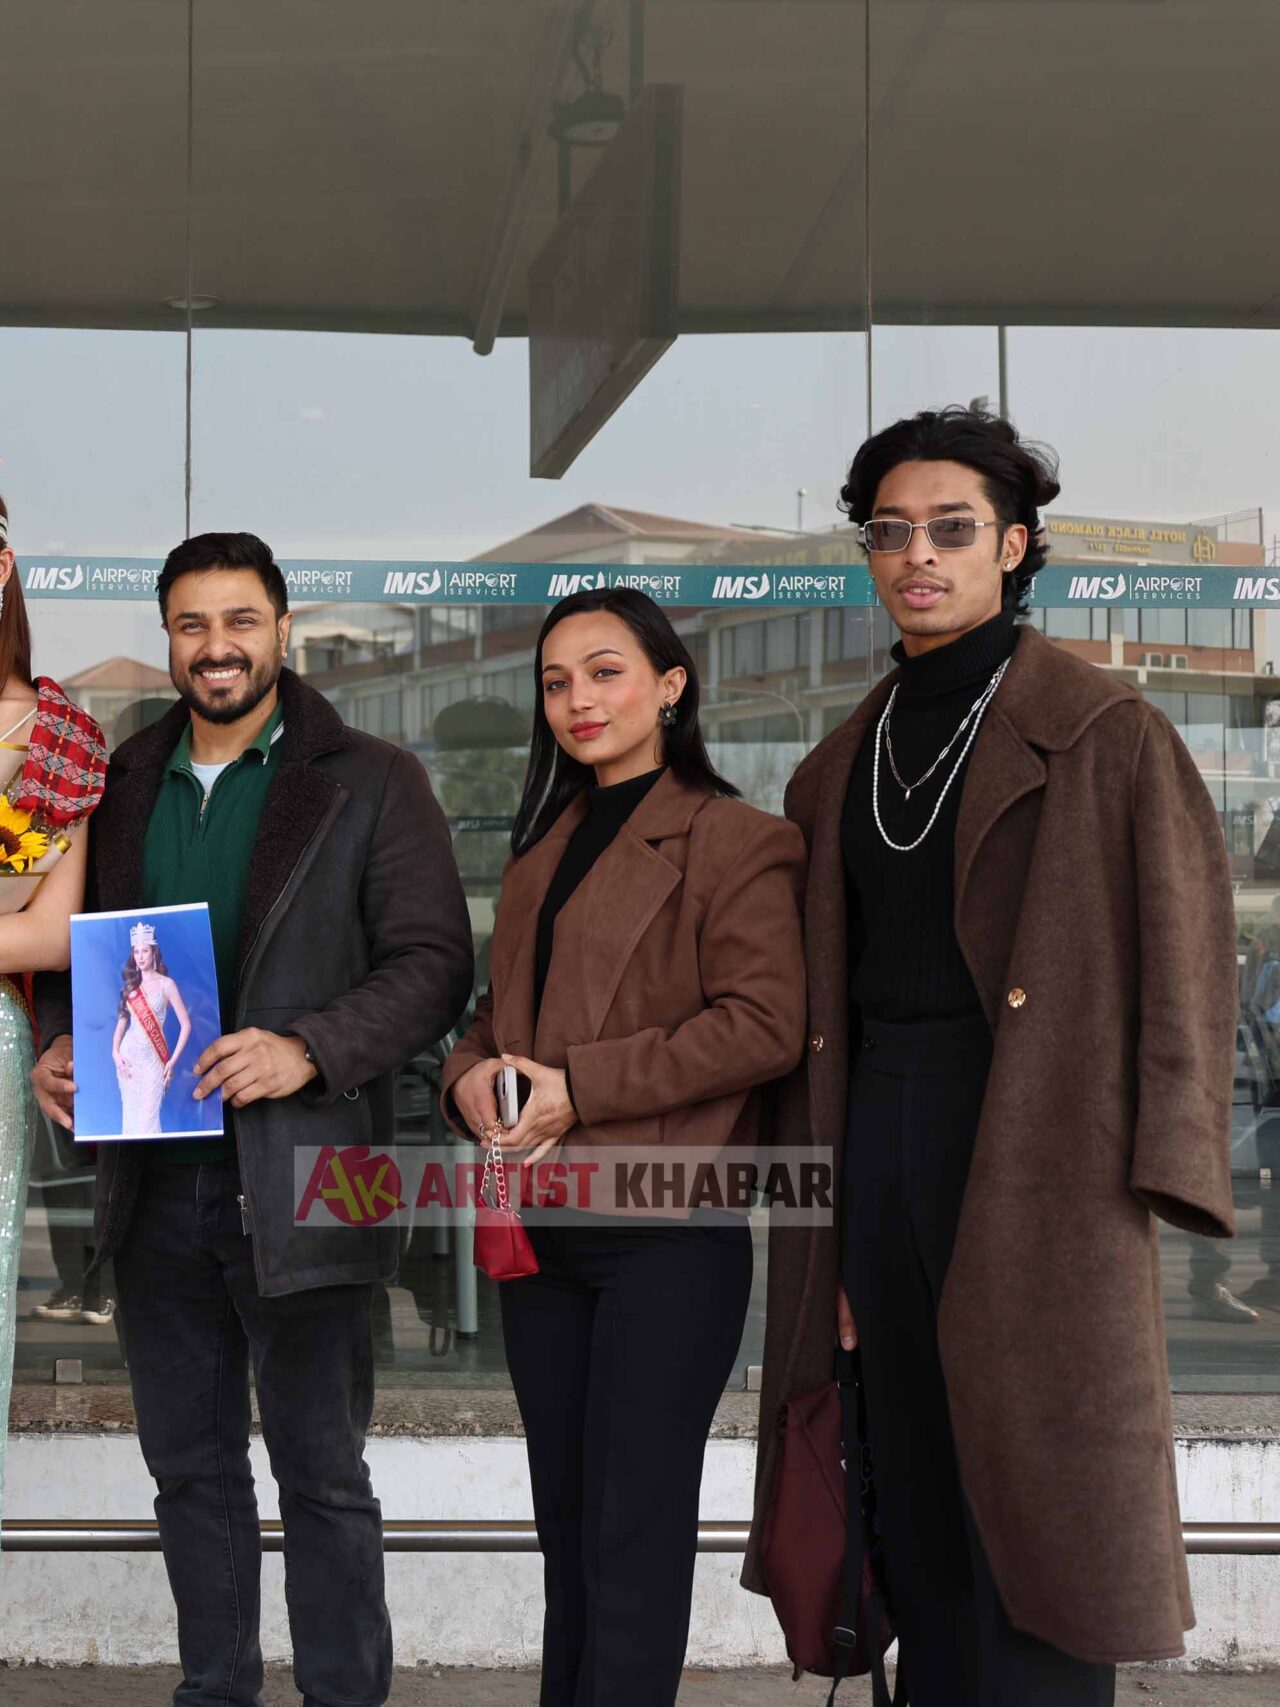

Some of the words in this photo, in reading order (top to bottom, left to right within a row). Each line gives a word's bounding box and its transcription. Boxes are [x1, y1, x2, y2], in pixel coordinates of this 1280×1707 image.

[26, 564, 84, 590] IMS
[91, 567, 160, 584] AIRPORT
[285, 569, 353, 586] AIRPORT
[383, 568, 442, 595] IMS
[450, 572, 517, 588] AIRPORT
[613, 575, 681, 590] AIRPORT
[778, 575, 846, 591] AIRPORT
[91, 583, 157, 591] SERVICES
[450, 588, 517, 596] SERVICES
[712, 572, 770, 599] IMS
[1068, 573, 1127, 600] IMS
[1134, 576, 1203, 592] AIRPORT
[1232, 577, 1280, 600] IMS
[778, 590, 845, 599] SERVICES
[1134, 592, 1201, 600] SERVICES
